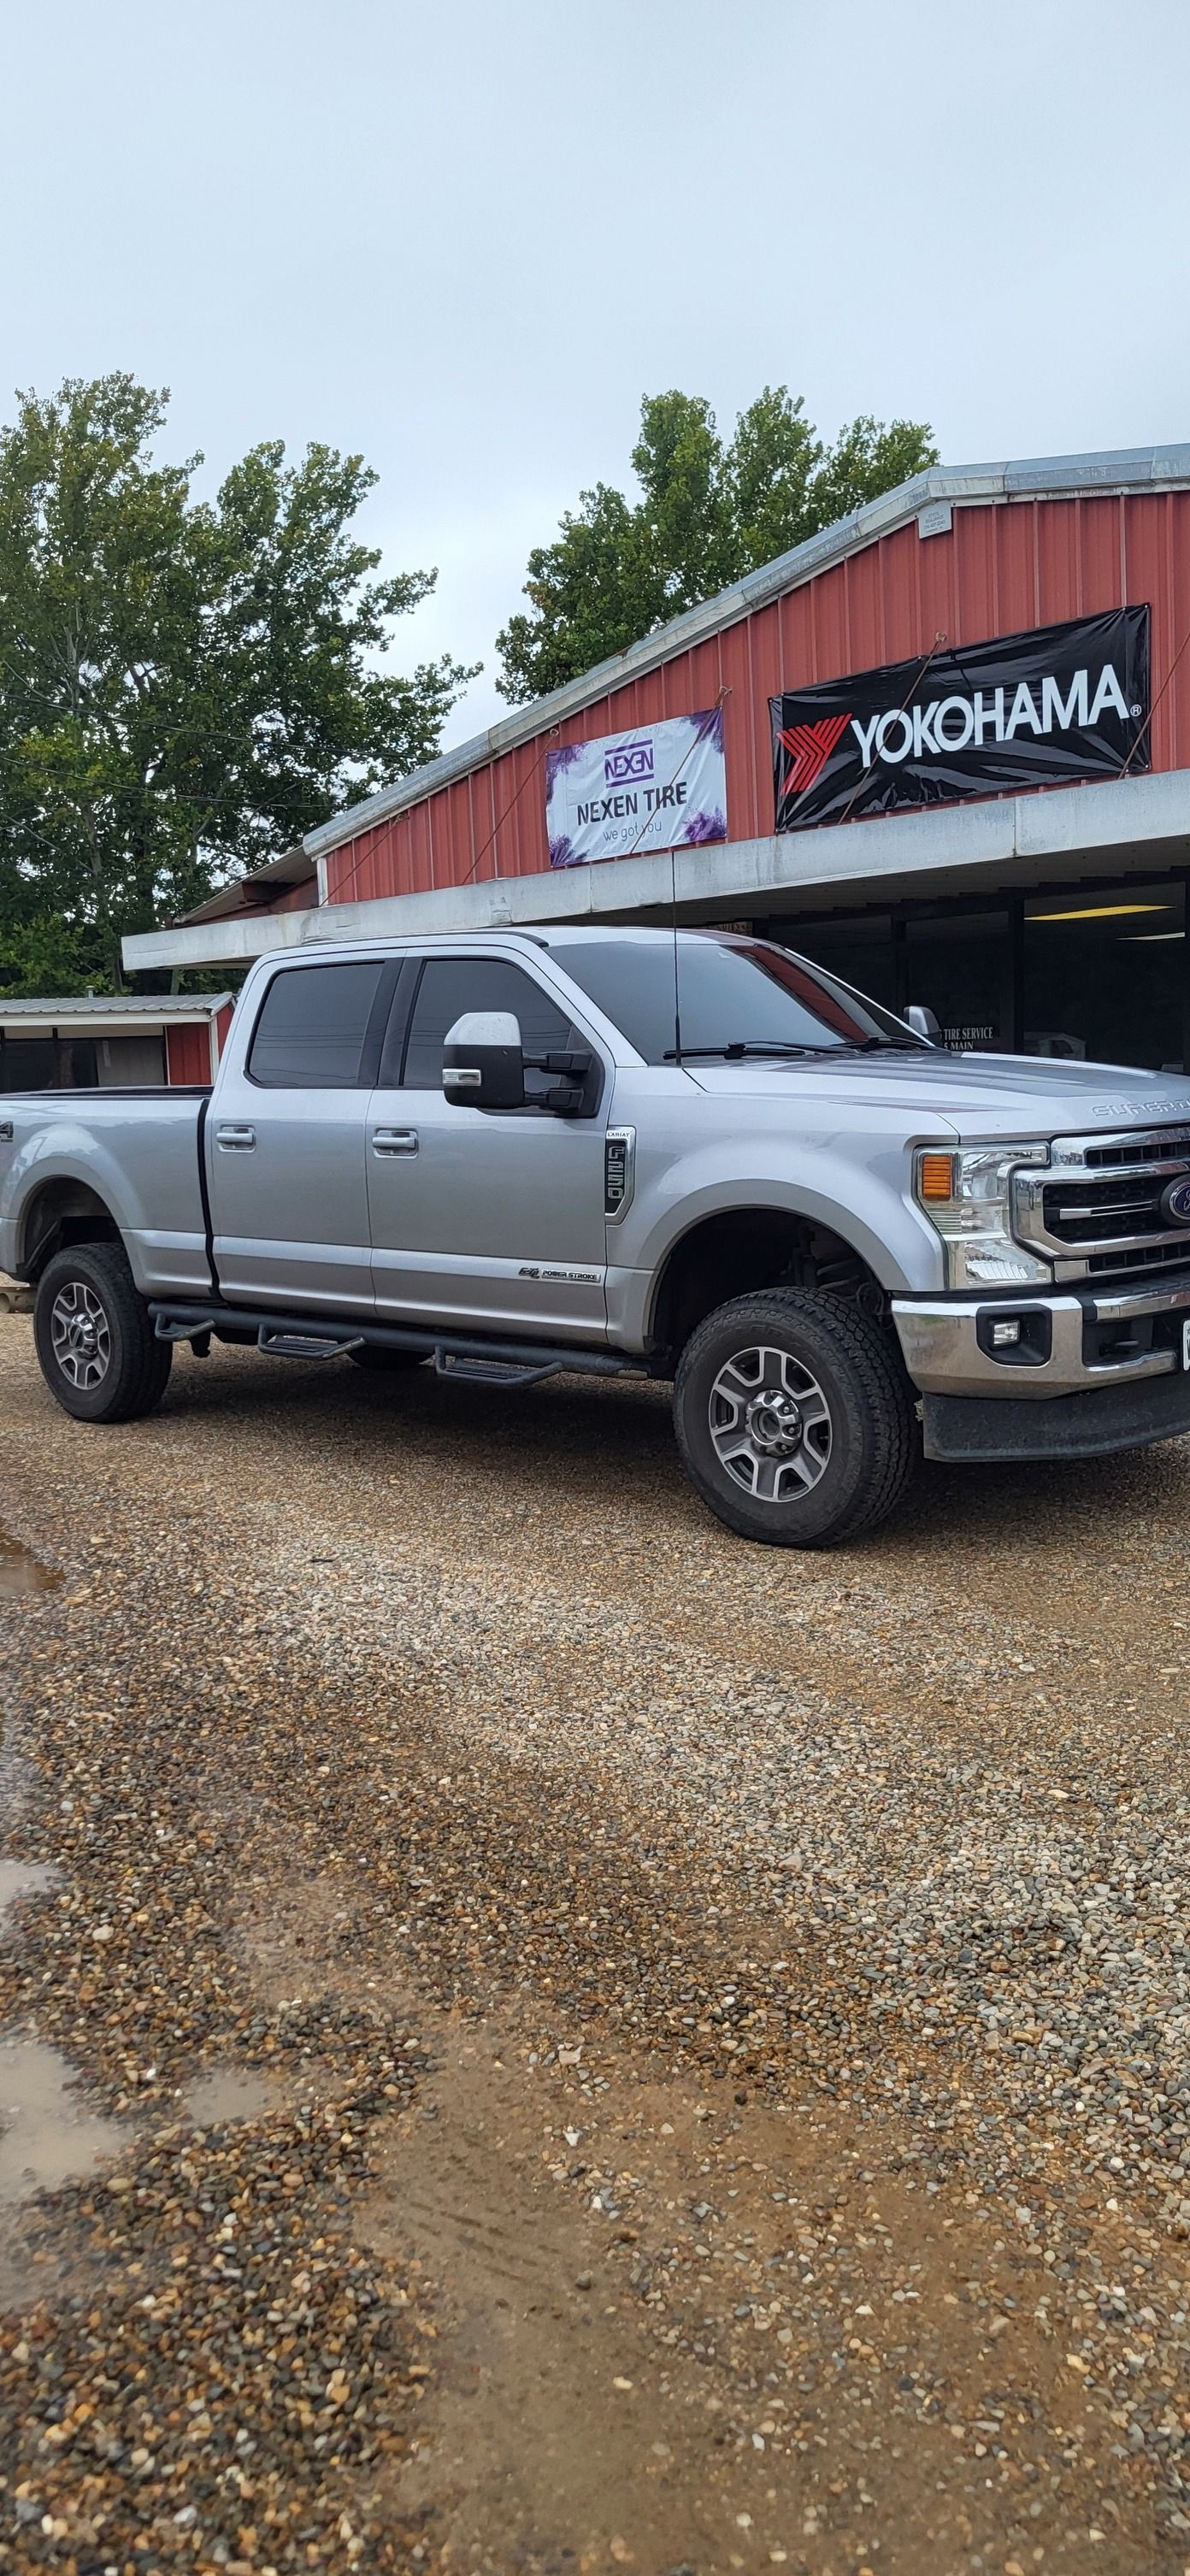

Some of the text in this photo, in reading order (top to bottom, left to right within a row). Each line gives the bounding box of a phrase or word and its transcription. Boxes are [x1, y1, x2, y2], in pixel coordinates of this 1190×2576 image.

[851, 664, 1130, 768] YOKOHAMA
[604, 748, 654, 781] NEXEN
[577, 781, 687, 826] NEXEN TIRE
[602, 821, 663, 842] we got you
[943, 1028, 961, 1040] TIRE
[962, 1027, 993, 1040] SERVICE
[950, 1040, 974, 1051] MAIN
[542, 1270, 567, 1278] POWER
[568, 1271, 598, 1280] STROKE
